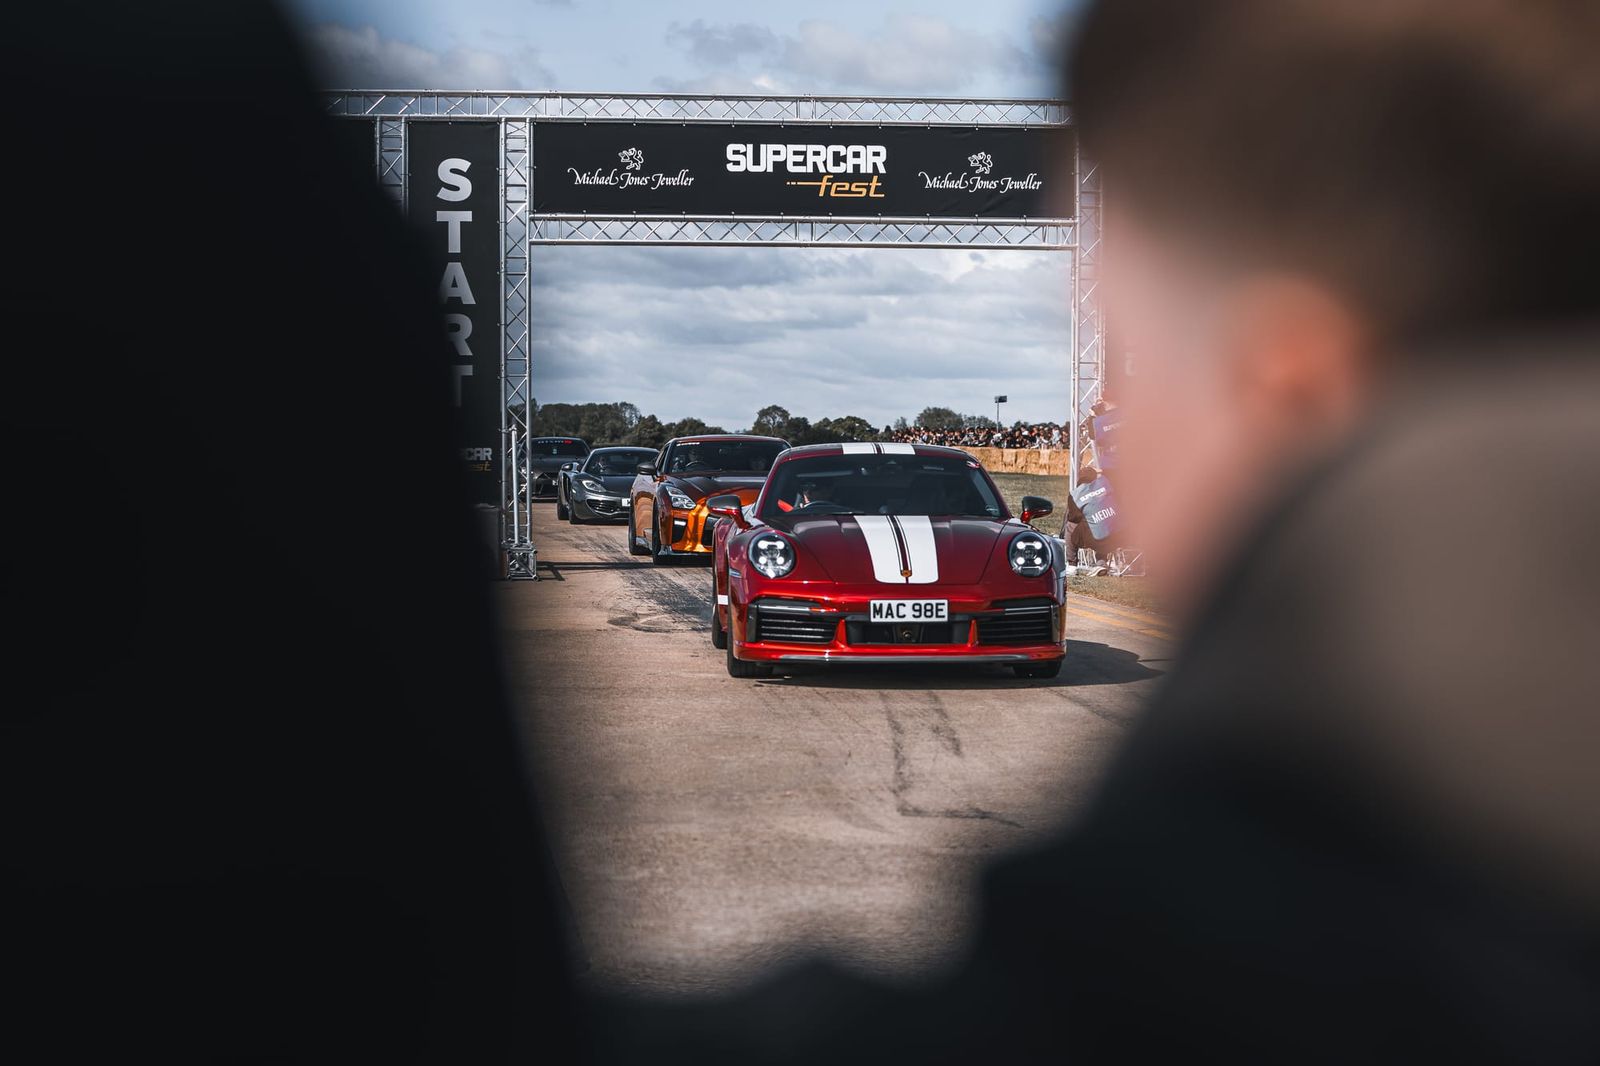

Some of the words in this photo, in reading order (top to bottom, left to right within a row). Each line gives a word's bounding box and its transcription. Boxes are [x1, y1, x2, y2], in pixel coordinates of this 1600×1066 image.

[726, 143, 887, 174] SUPERCAR
[567, 167, 619, 185] Michael
[619, 172, 650, 189] Jones
[651, 169, 694, 190] Jeweller
[797, 175, 885, 197] fest
[918, 171, 968, 189] Michael
[969, 176, 999, 193] Jones
[1000, 173, 1042, 193] Jeweller
[1091, 507, 1116, 524] MEDIA
[872, 603, 906, 619] MAC
[912, 603, 945, 619] 98E
